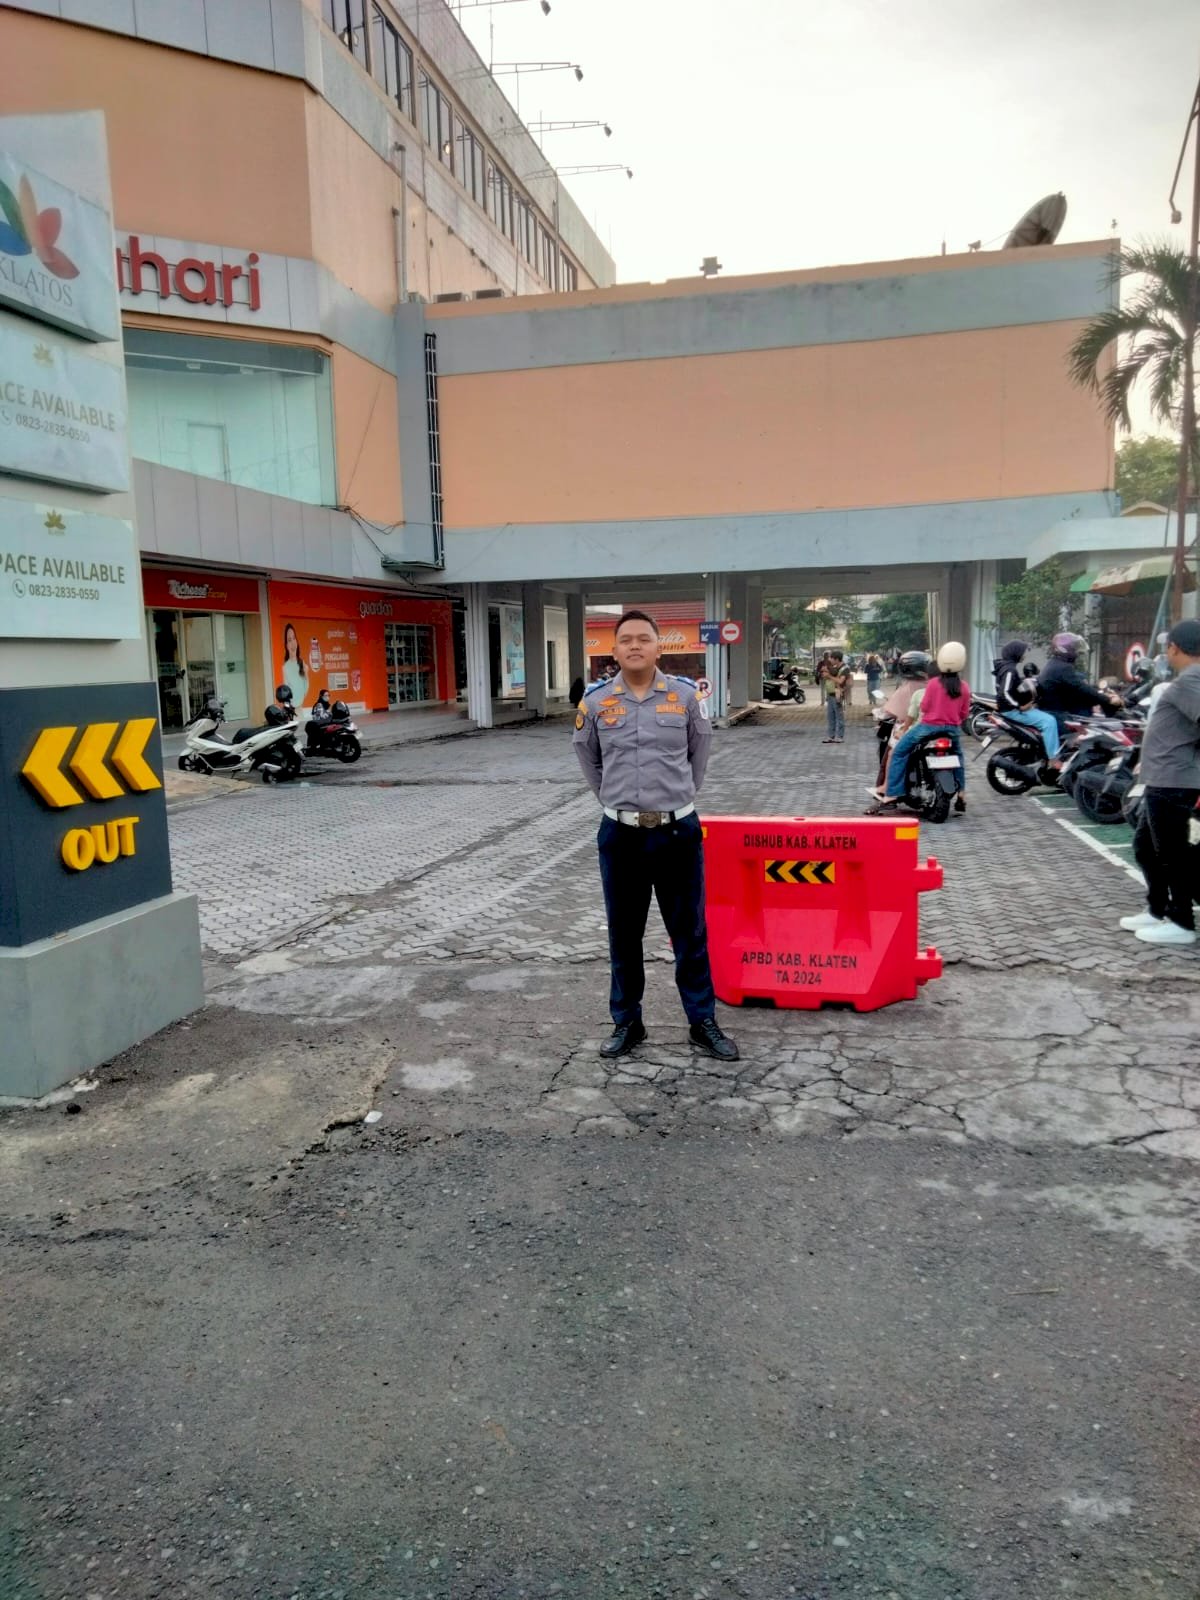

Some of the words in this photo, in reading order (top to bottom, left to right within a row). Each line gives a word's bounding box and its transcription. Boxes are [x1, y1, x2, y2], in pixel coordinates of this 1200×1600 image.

[116, 236, 260, 311] hari
[32, 389, 116, 432] AVAILABLE
[15, 413, 91, 443] 0823-2835-0550
[43, 557, 126, 584] AVAILABLE
[29, 584, 100, 600] 0823-2835-0550
[62, 816, 140, 871] OUT
[743, 834, 783, 848] DISHUB
[786, 835, 811, 849] KAB.
[814, 836, 857, 849] KLATEN
[741, 952, 773, 965] APBD
[776, 953, 805, 967] KAB.
[809, 954, 857, 968] KLATEN
[775, 970, 790, 984] TA
[793, 971, 822, 985] 2024
